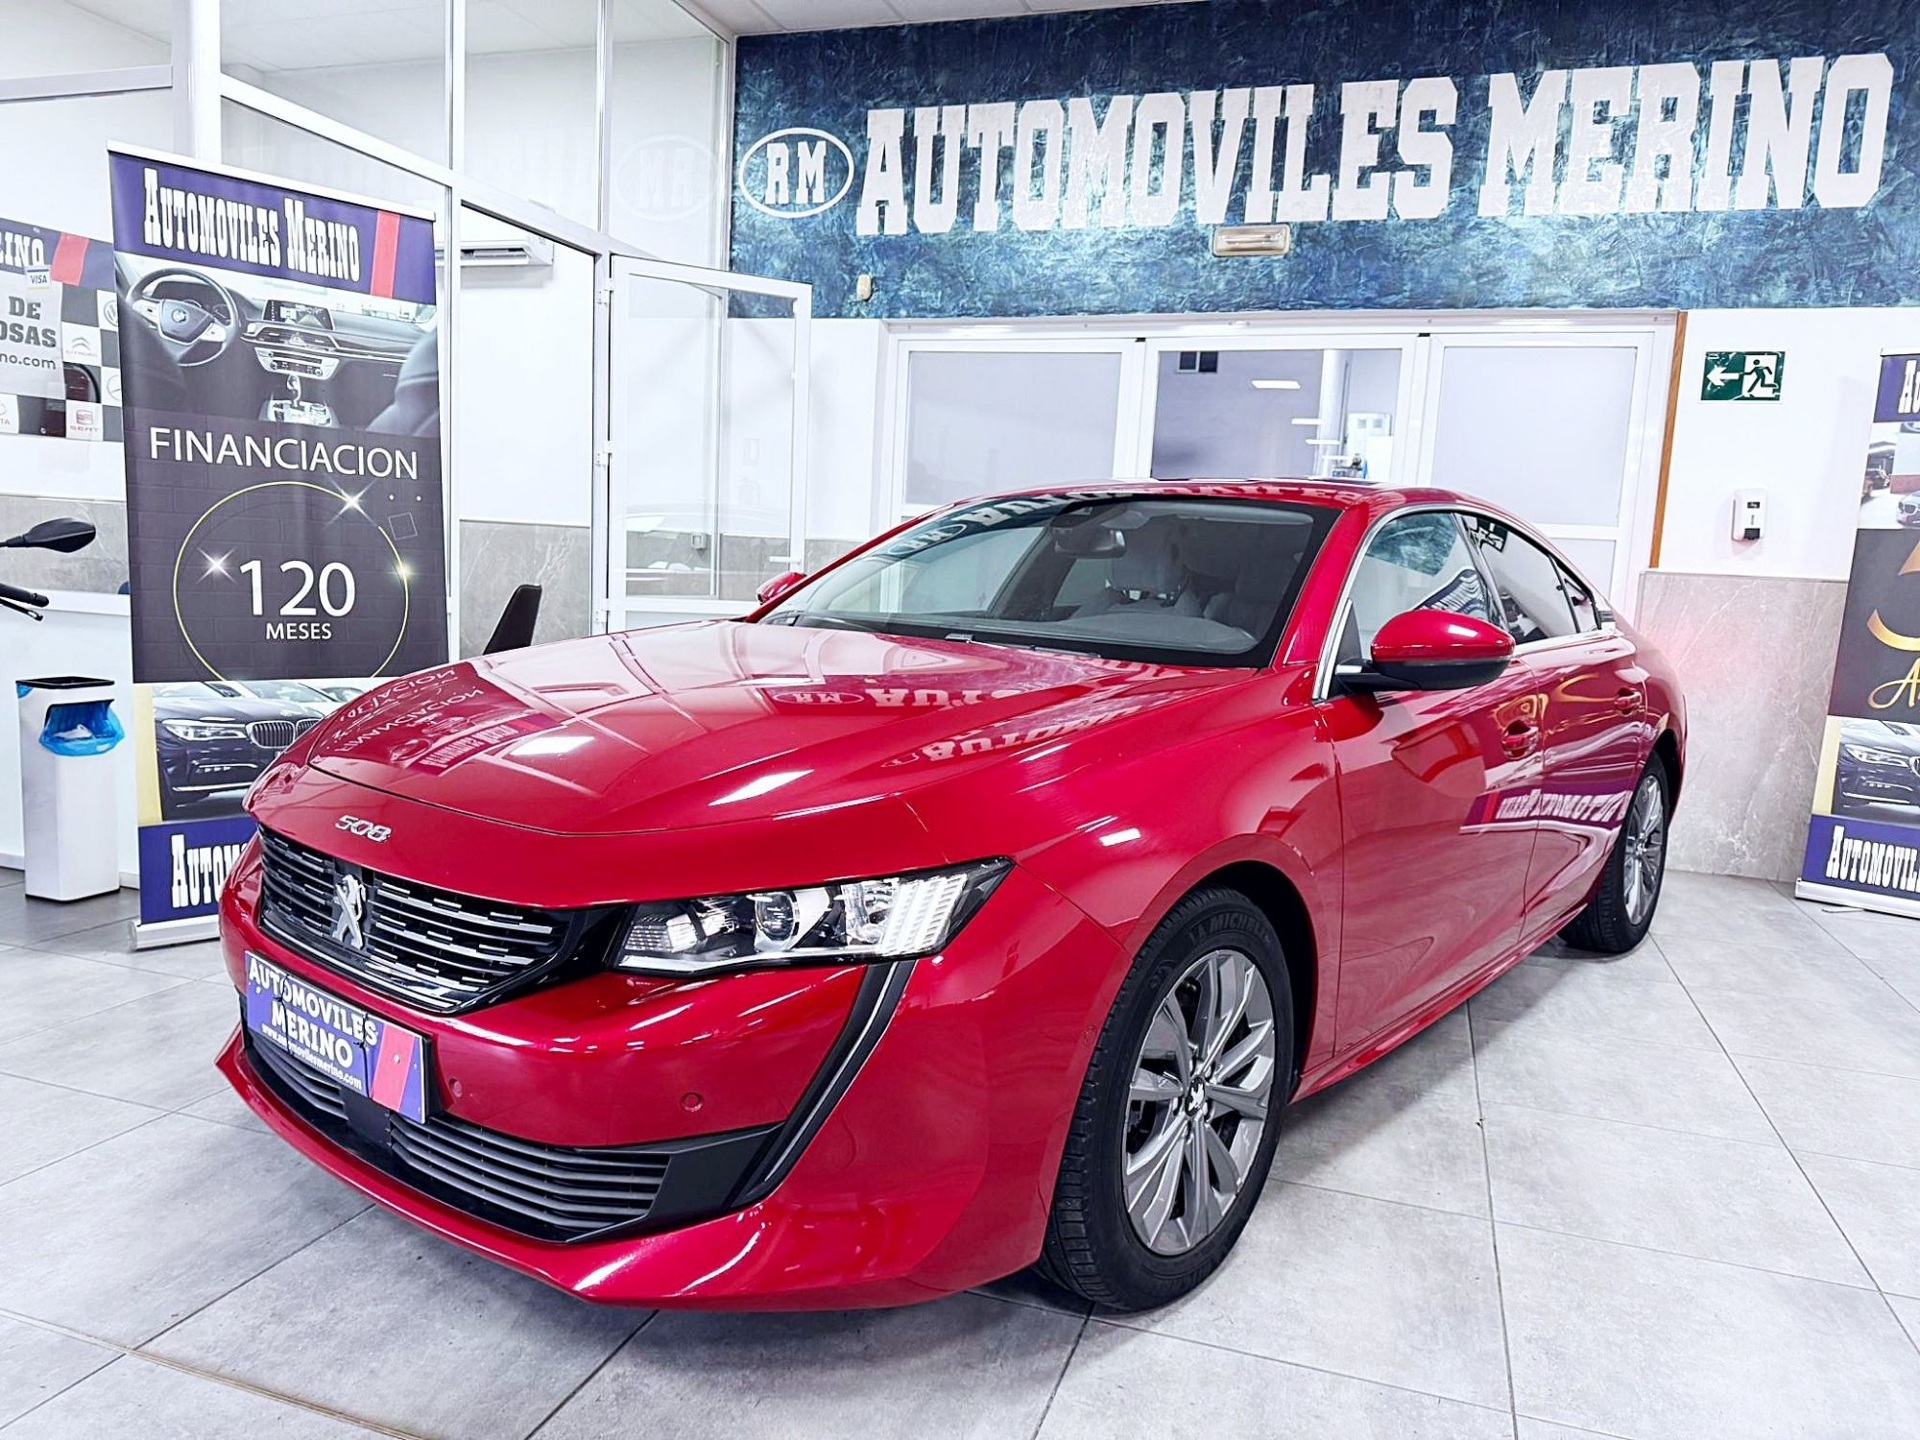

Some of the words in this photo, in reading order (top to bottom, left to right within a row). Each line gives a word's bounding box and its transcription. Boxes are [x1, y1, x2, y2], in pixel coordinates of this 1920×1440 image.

[764, 141, 826, 205] RM
[856, 76, 1458, 236] AUTOMOVILES
[1479, 53, 1894, 217] MERINO
[9, 296, 41, 320] DE
[149, 427, 418, 480] FINANCIACION
[239, 560, 356, 617] 120
[265, 622, 332, 640] MESES
[334, 814, 392, 843] 508
[249, 958, 378, 1046] AUTOMOVILES
[271, 1001, 354, 1068] MERINO
